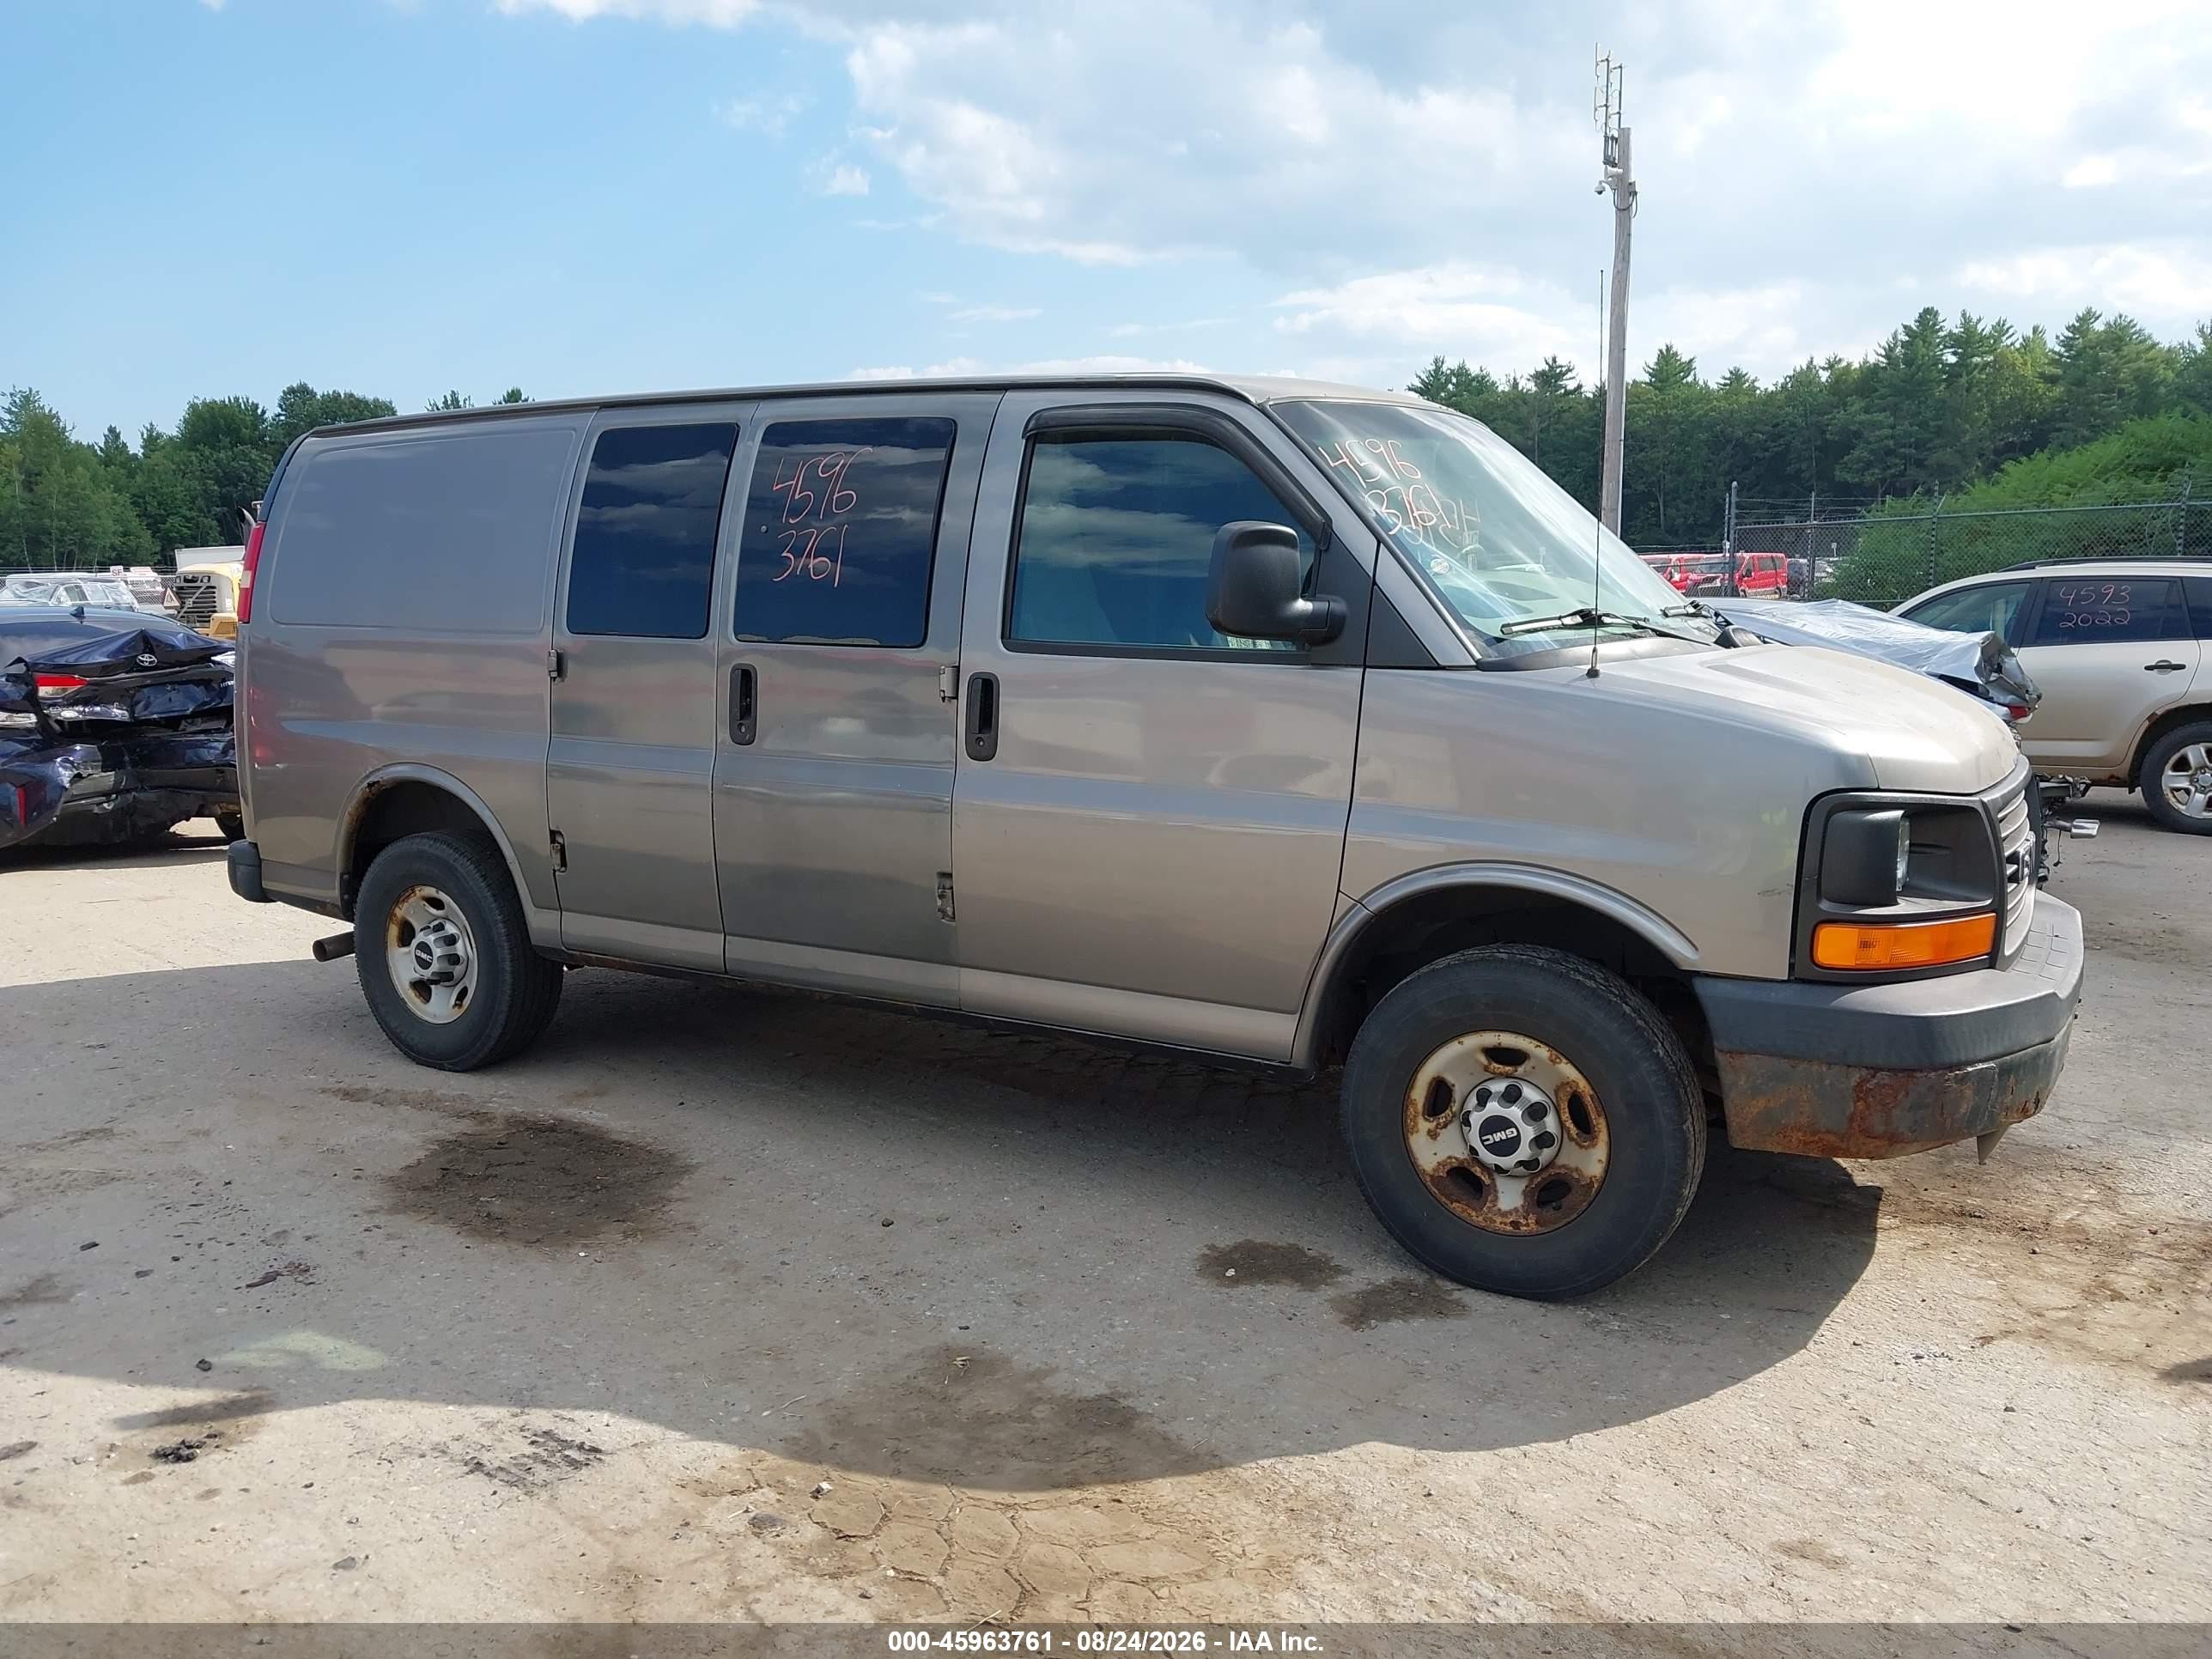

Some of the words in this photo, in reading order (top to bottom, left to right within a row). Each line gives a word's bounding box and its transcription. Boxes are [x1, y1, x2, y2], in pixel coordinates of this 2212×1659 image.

[1318, 438, 1421, 489] 4596
[773, 447, 873, 524] 4596
[1364, 482, 1451, 535] 3761
[773, 524, 848, 588] 3761
[2059, 584, 2131, 607] 4593
[2059, 607, 2130, 629] 2022
[416, 949, 433, 963] GMC
[1481, 1127, 1518, 1146] GMC
